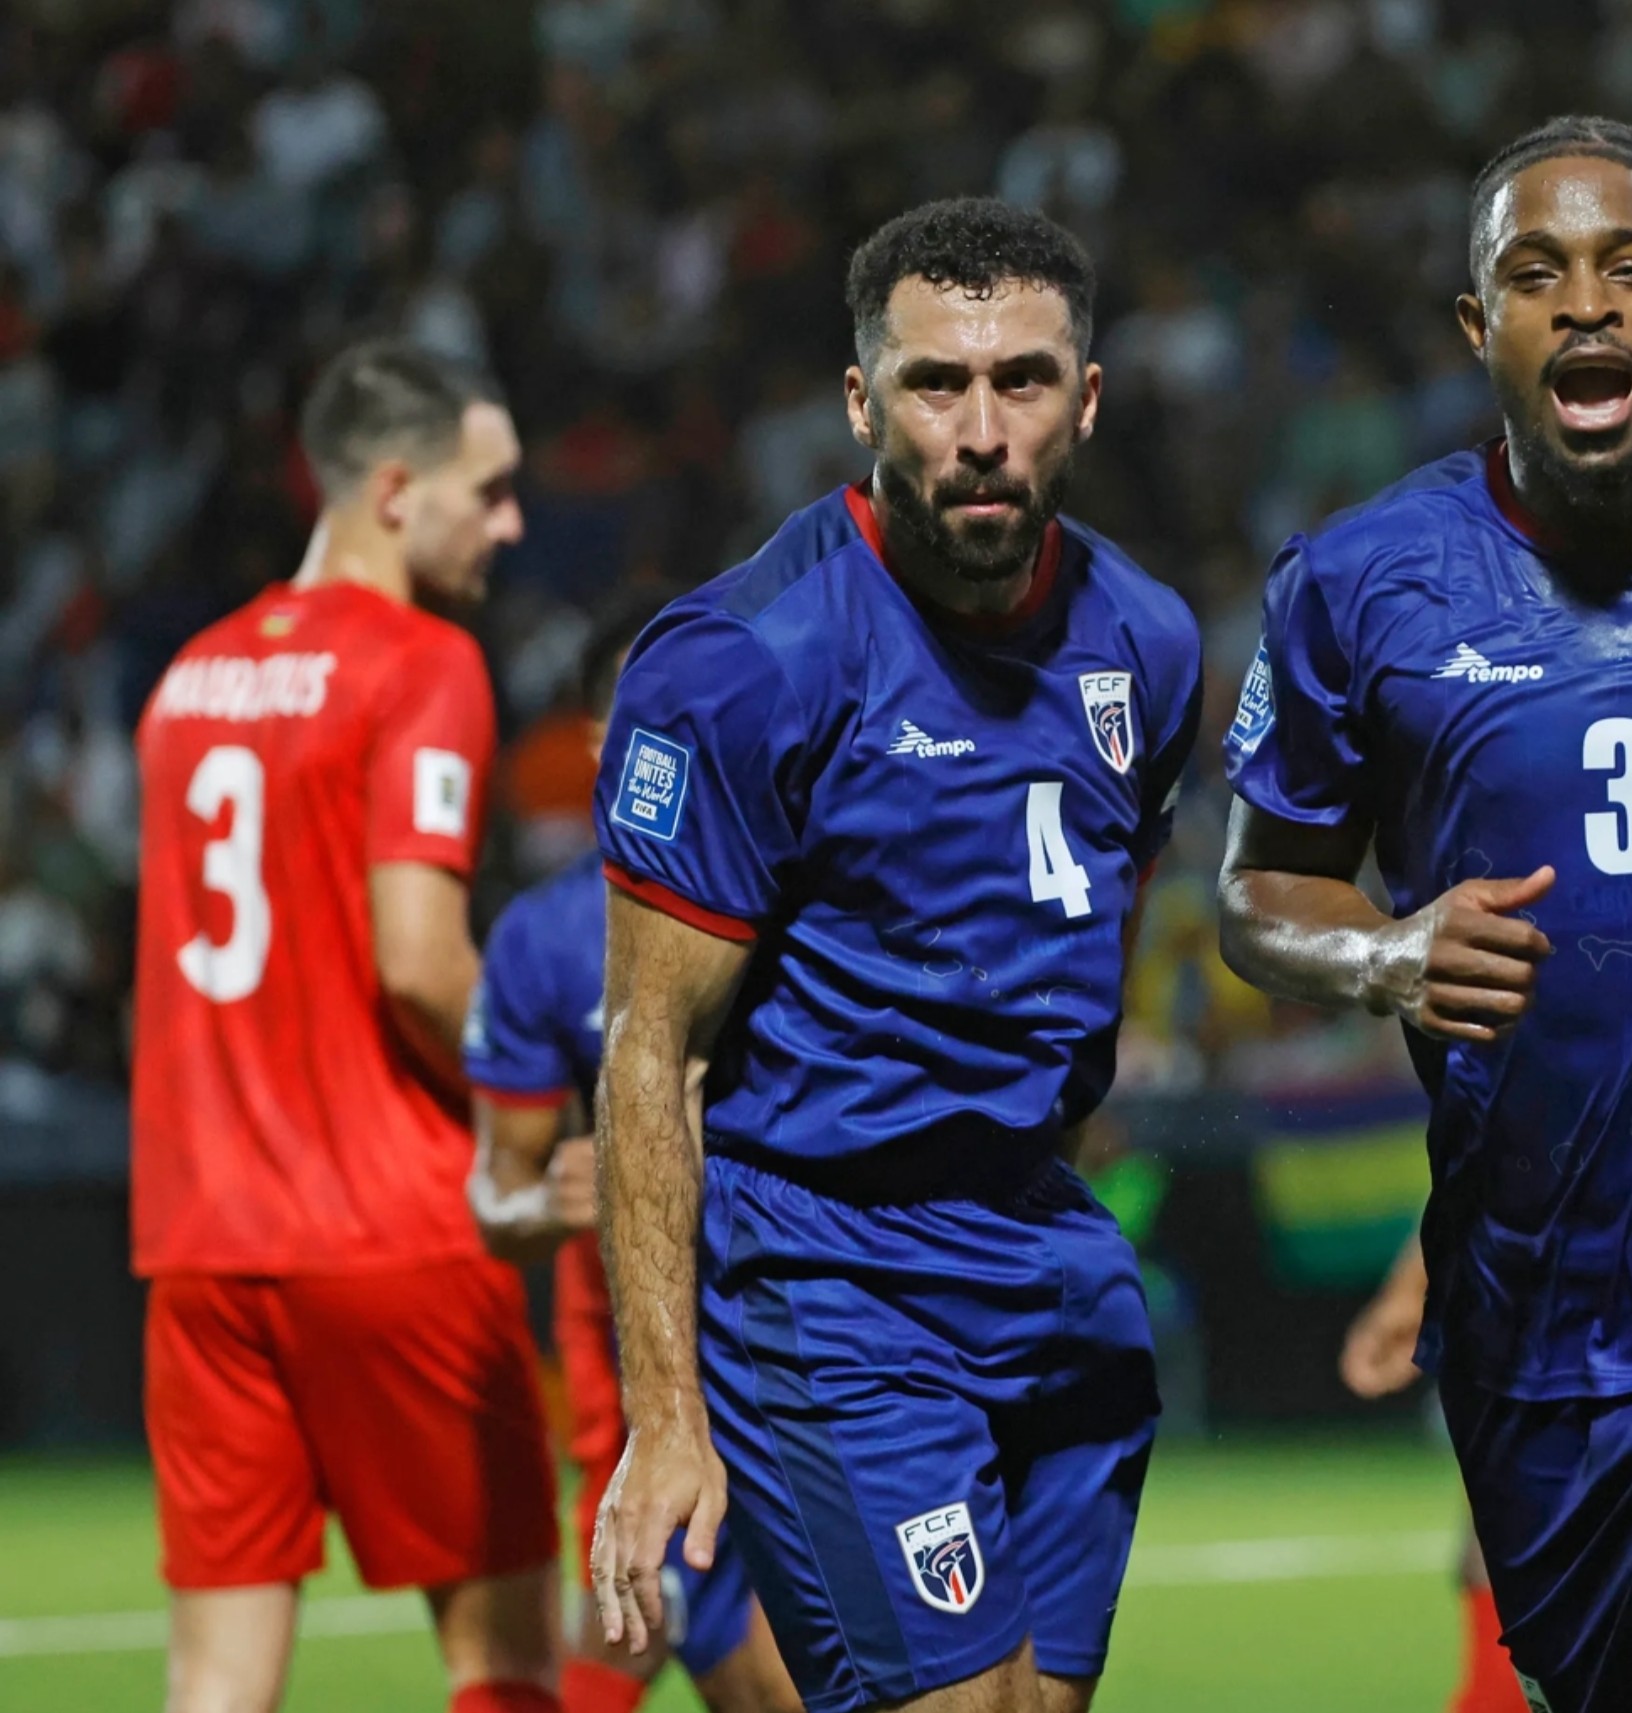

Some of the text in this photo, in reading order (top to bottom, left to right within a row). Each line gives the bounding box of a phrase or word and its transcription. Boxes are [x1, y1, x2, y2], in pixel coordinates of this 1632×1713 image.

[1083, 676, 1127, 694] FCF
[1467, 664, 1543, 684] tempo
[639, 744, 677, 772] FOOTBALL
[918, 739, 976, 759] tempo
[633, 758, 676, 790] UNITES
[634, 802, 653, 816] FIFA
[641, 781, 674, 809] World
[1026, 782, 1092, 919] 4
[177, 744, 273, 1004] 3
[904, 1509, 962, 1543] FCF
